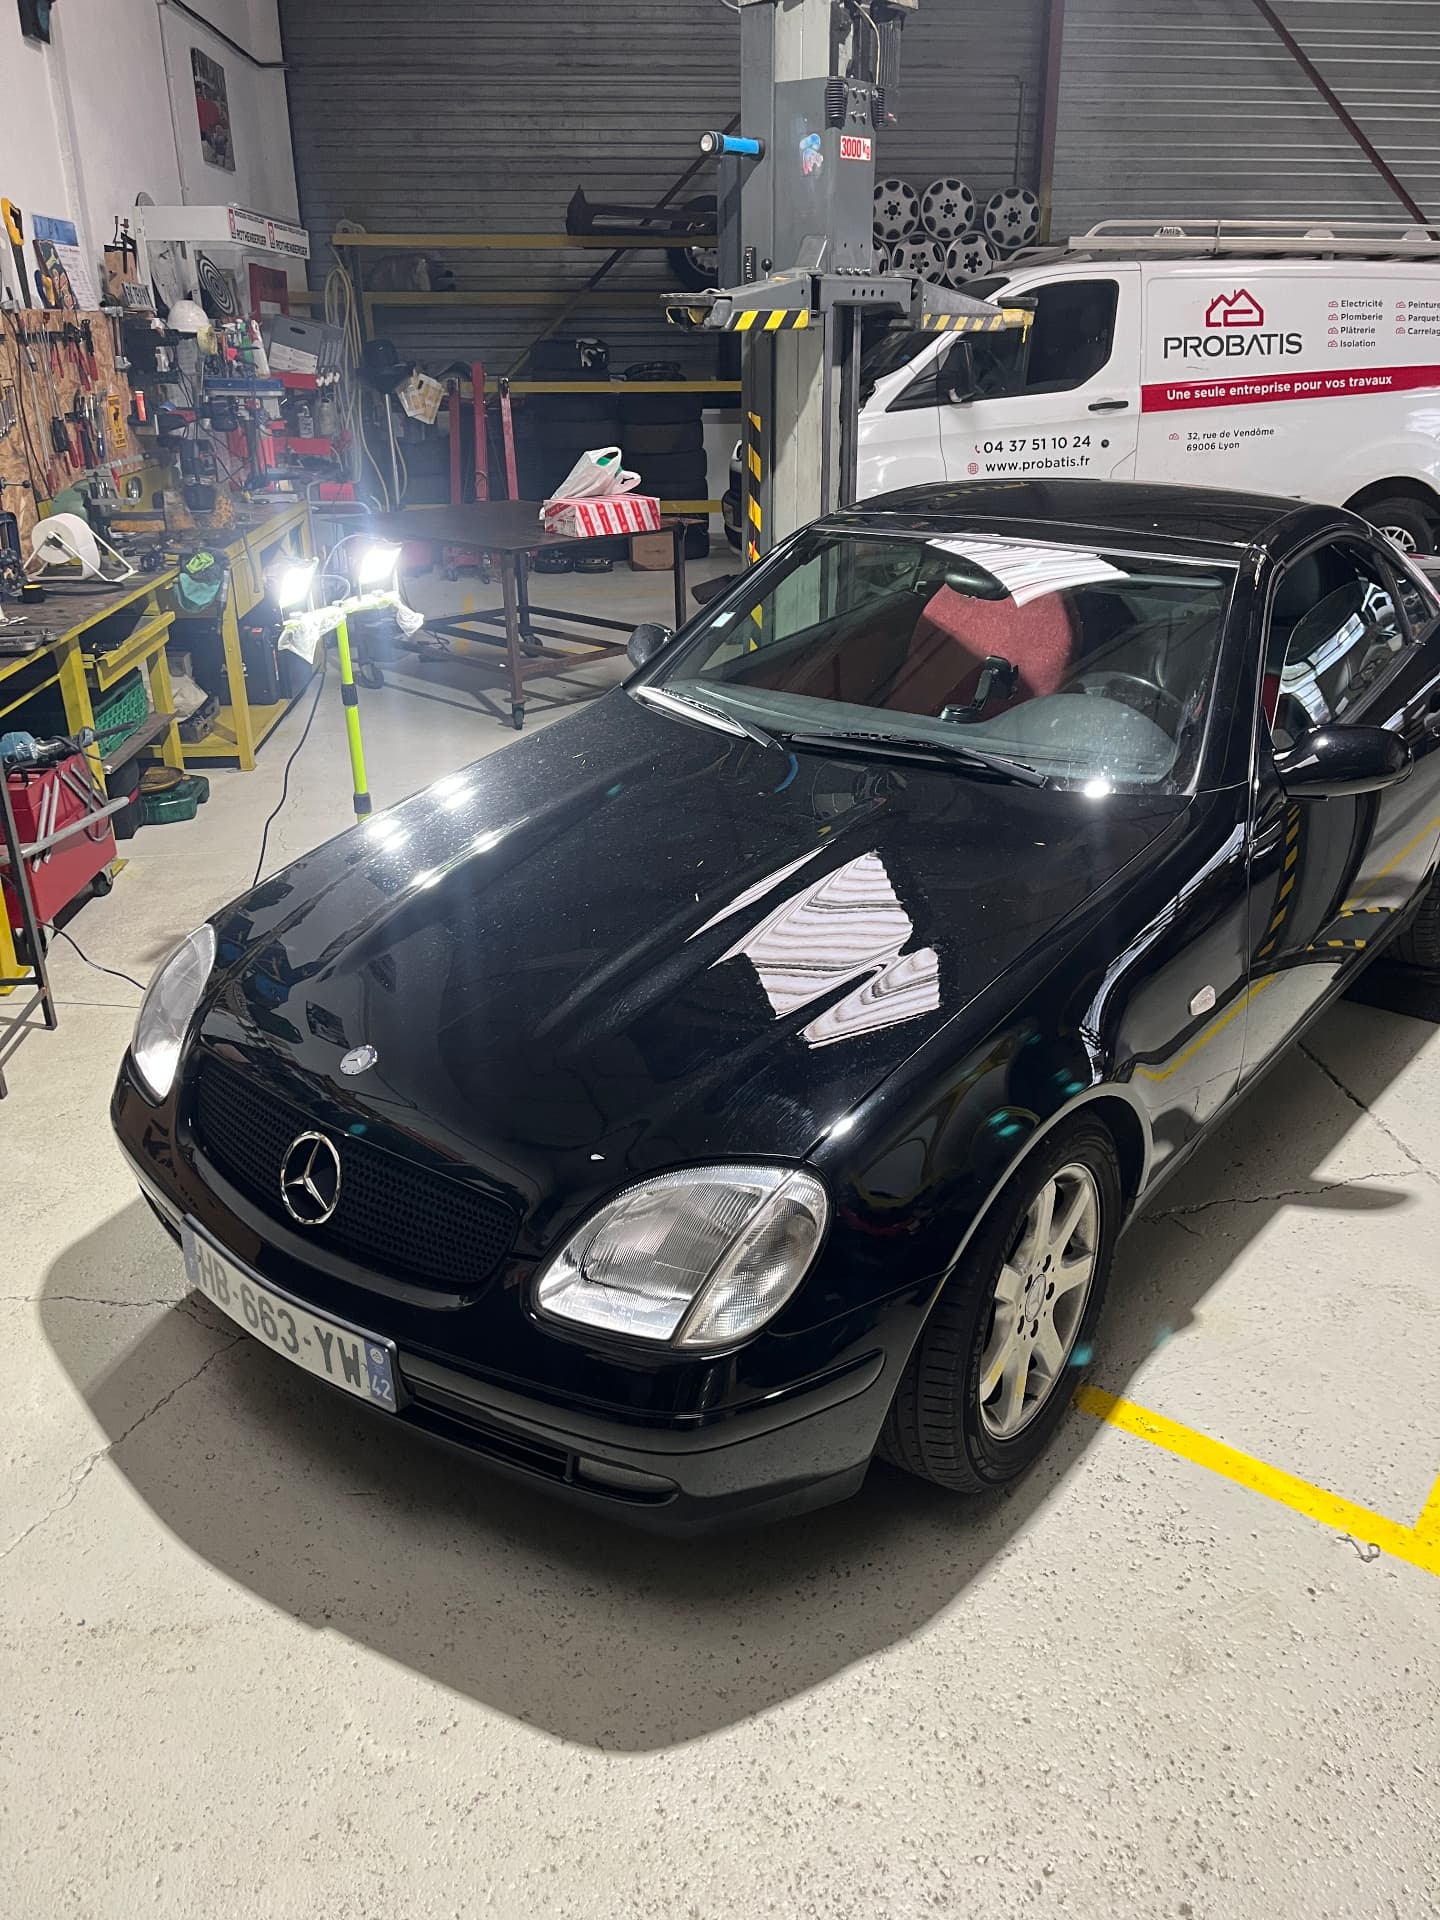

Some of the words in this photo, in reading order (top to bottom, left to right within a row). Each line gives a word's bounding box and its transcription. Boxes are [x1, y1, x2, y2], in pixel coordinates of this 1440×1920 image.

[842, 137, 861, 158] 3000
[863, 140, 870, 159] kg
[1340, 299, 1383, 308] Electricité
[1340, 312, 1383, 321] Plomberie
[1340, 325, 1376, 334] Plâtrerie
[1163, 333, 1303, 359] PROBATIS
[1340, 339, 1376, 348] Isolation
[1167, 389, 1191, 400] Une
[1194, 386, 1226, 398] seule
[1229, 381, 1291, 396] entreprise
[1294, 380, 1322, 393] pour
[1325, 379, 1346, 389] vos
[1349, 375, 1393, 387] travaux
[1187, 432, 1201, 441] 32,
[1202, 432, 1217, 440] rue
[1219, 430, 1231, 438] de
[1233, 428, 1275, 438] Vendôme
[983, 441, 1004, 454] 04
[1009, 439, 1027, 452] 37
[1032, 438, 1046, 451] 51
[1051, 436, 1068, 449] 10
[1072, 435, 1091, 448] 24
[1186, 442, 1216, 452] 69006
[1218, 441, 1240, 450] Lyon
[985, 455, 1091, 473] www.probatis.fr
[200, 1246, 362, 1388] HB-663-YW
[370, 1375, 393, 1402] 42
